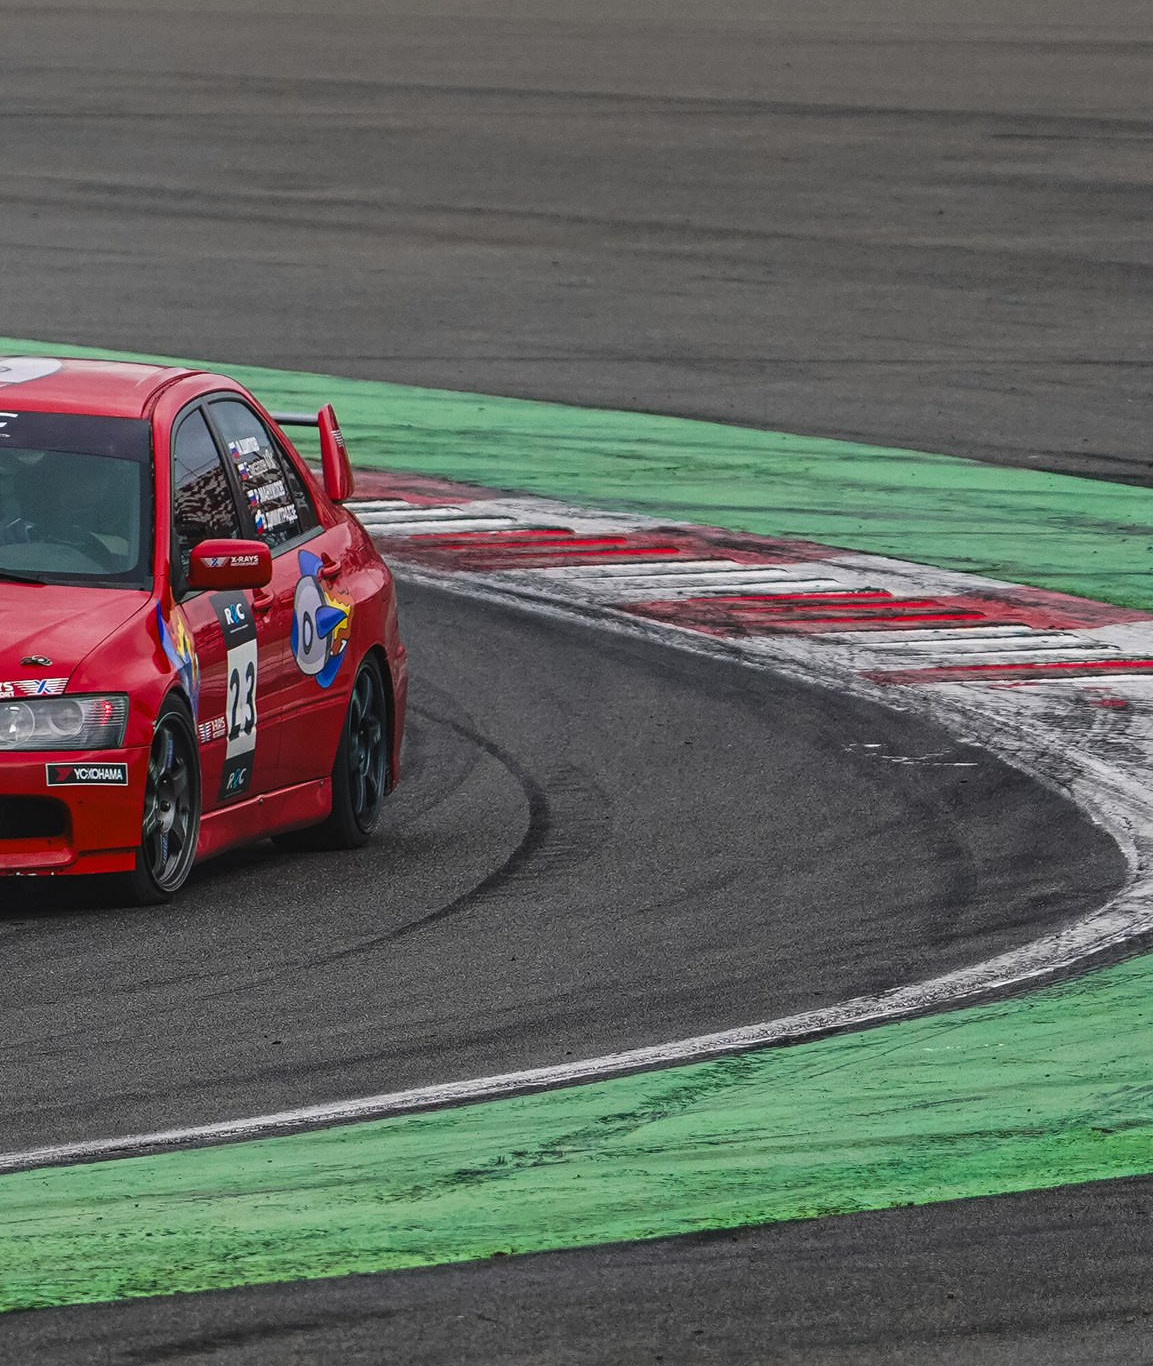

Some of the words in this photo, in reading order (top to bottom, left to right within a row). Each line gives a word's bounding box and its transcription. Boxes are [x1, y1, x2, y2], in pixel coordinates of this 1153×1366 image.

[231, 555, 259, 564] X-RAYS
[229, 661, 255, 742] 23
[73, 767, 123, 780] YOKOHAMA
